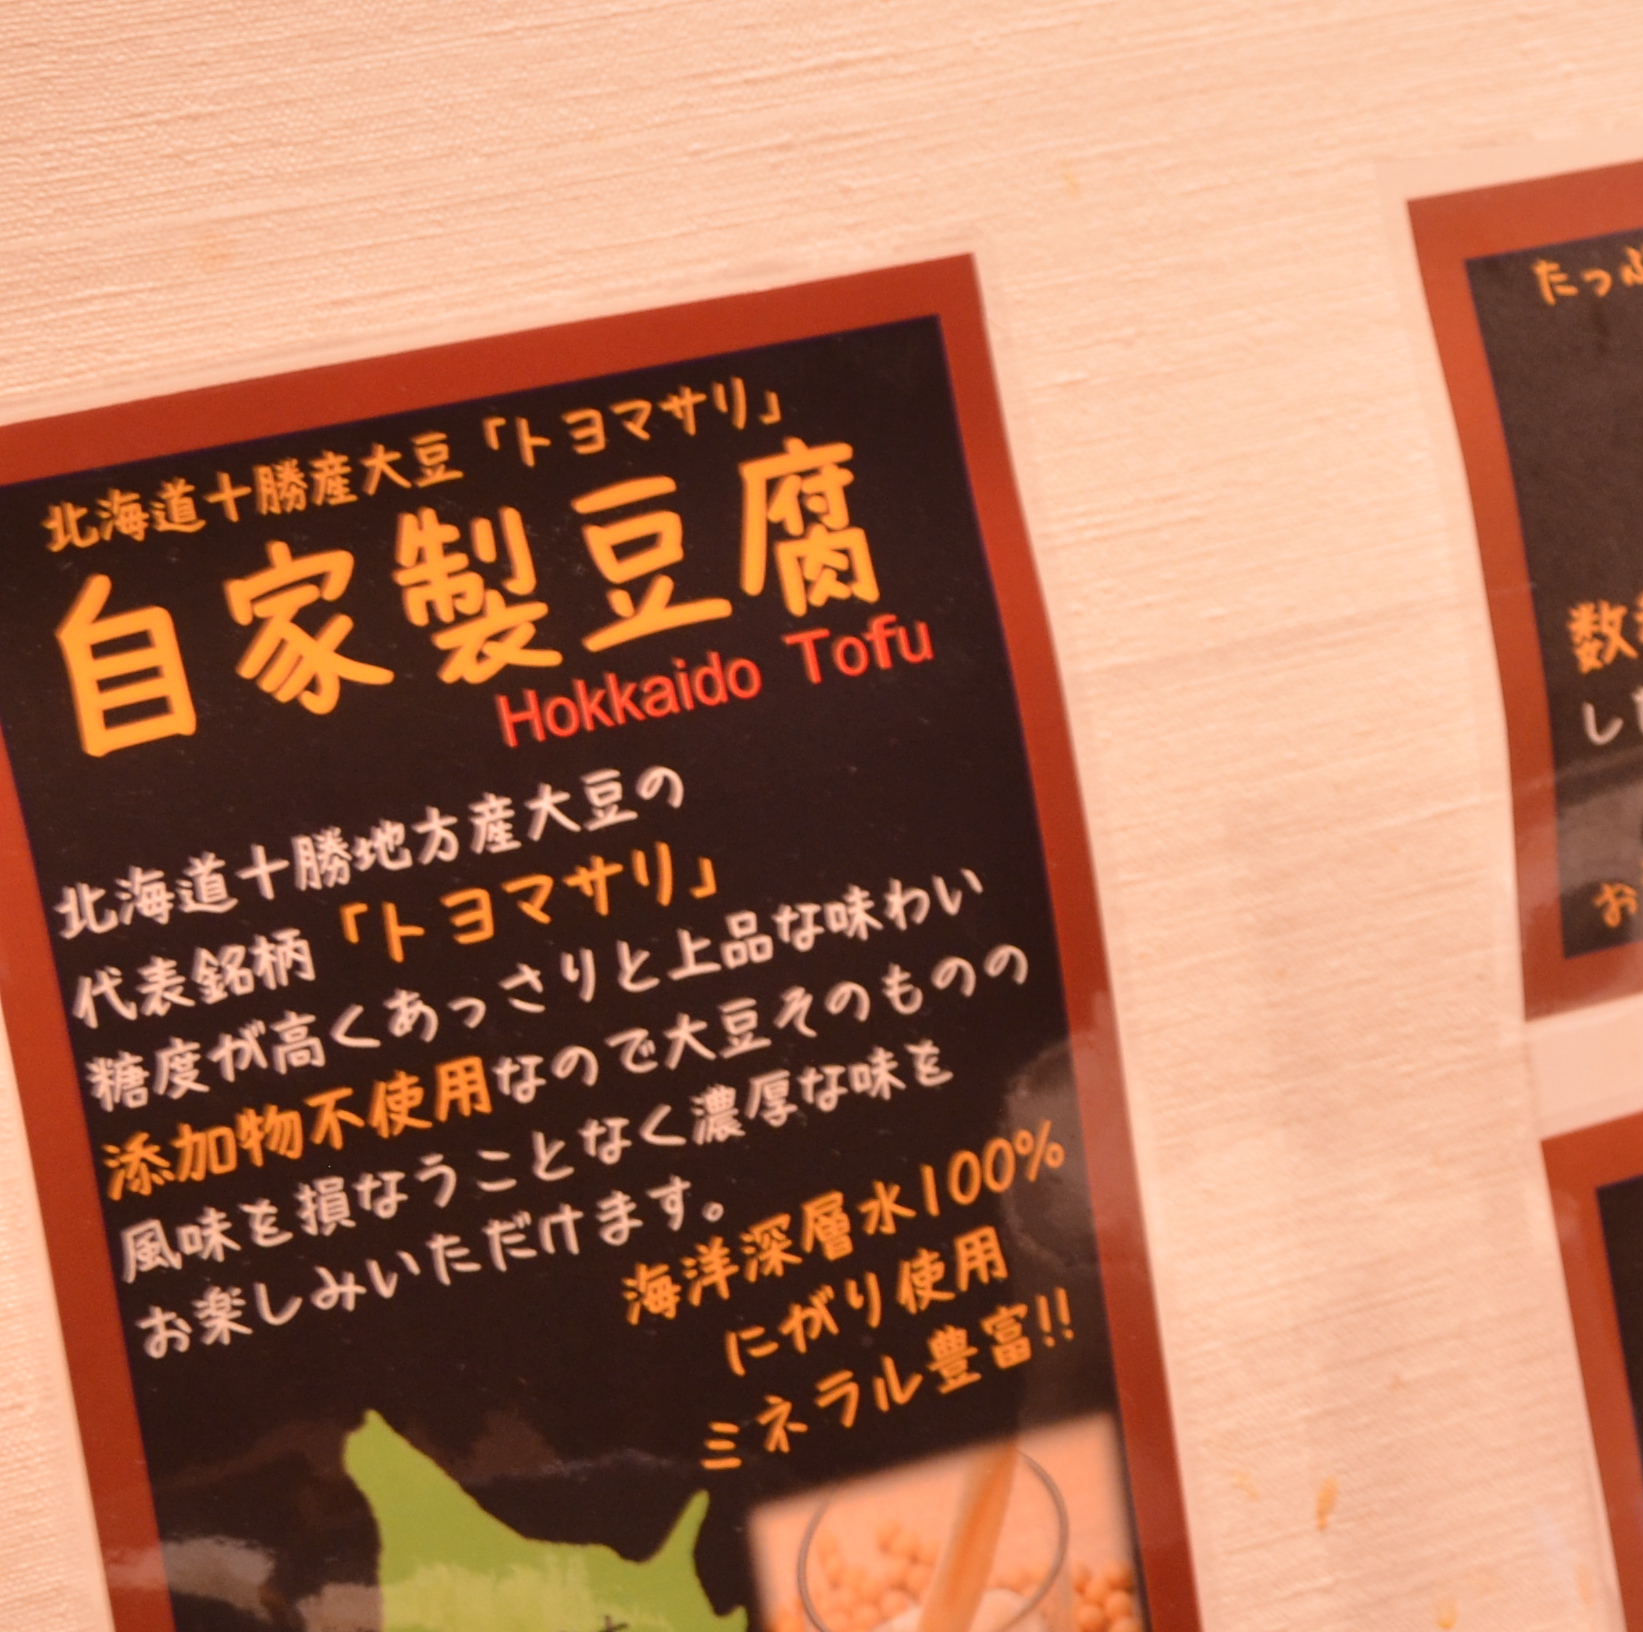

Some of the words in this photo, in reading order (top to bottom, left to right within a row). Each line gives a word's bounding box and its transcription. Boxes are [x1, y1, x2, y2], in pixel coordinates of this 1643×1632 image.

[45, 378, 781, 550] 北海道十勝産大豆「トヨマサリ」
[56, 437, 879, 757] 自家製豆腐
[496, 654, 762, 748] Hokkaido
[783, 612, 934, 685] Tofu
[58, 765, 685, 940] 北海道十勝地方産大豆の
[74, 842, 720, 1029] 代表銘柄「トヨマサリ」
[87, 868, 985, 1111] 糖度が高くあっさりと上品な味わい
[104, 943, 1030, 1200] 添加物不使用なので大豆そのものの
[120, 1042, 955, 1285] 風味を損なうことなく濃厚な味を
[621, 1119, 1068, 1327] 海洋深層水100%
[136, 1176, 727, 1360] お楽しみいただけます。
[724, 1225, 1009, 1376] にがり使用
